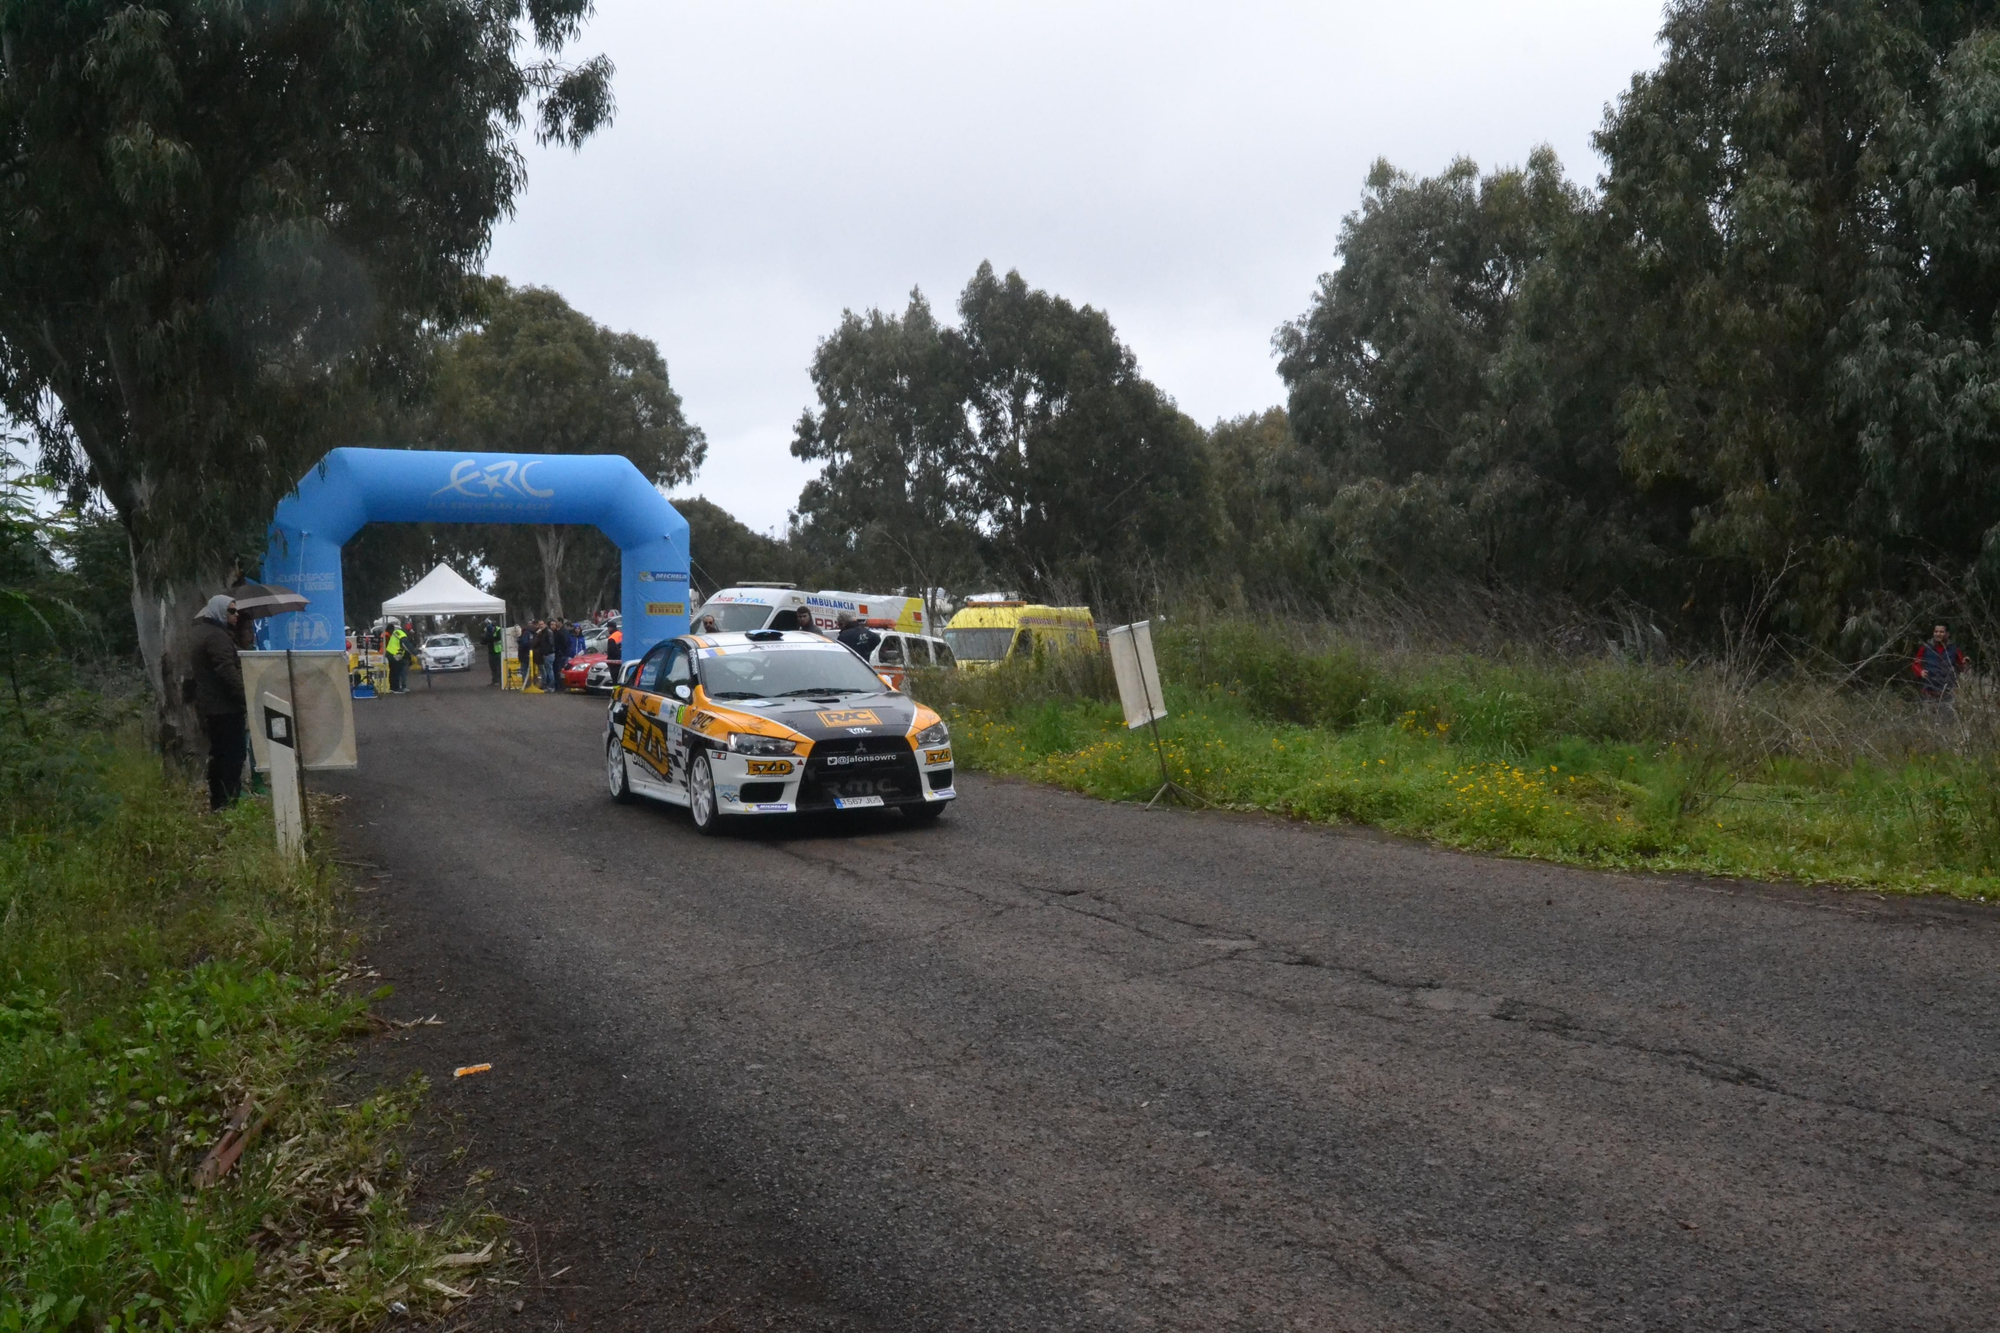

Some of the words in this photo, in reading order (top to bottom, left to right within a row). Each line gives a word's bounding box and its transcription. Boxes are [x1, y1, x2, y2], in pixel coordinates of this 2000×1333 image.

[806, 596, 855, 611] AMBULANCIA
[824, 711, 873, 722] RAC
[837, 754, 896, 765] @jalonsowrc
[746, 759, 795, 775] EZD
